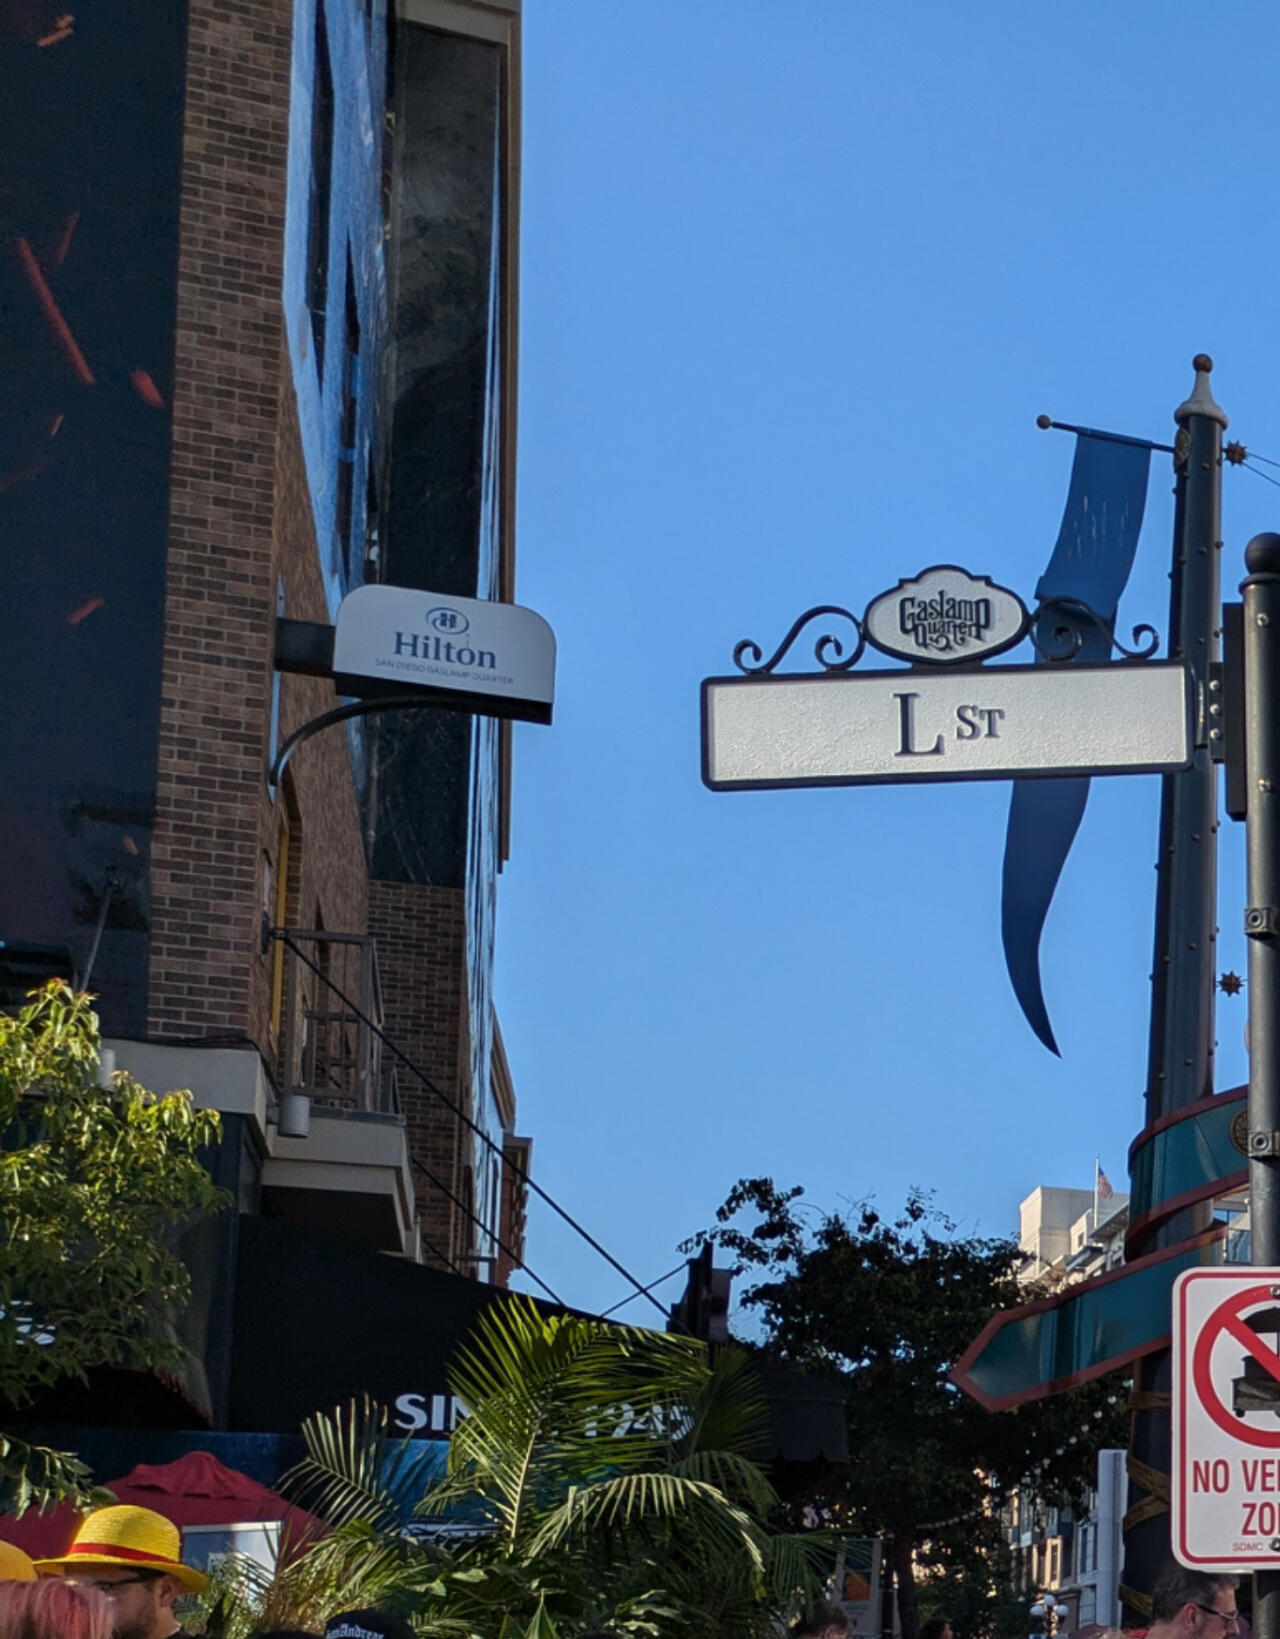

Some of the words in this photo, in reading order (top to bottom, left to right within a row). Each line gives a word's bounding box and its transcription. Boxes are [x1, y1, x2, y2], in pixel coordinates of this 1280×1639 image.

[900, 589, 991, 635] Gaslamp
[394, 631, 497, 669] Hilton
[914, 619, 984, 652] Quarter
[375, 657, 395, 668] SAN
[396, 660, 424, 673] DIEGO
[426, 665, 470, 679] GASLAMP
[471, 671, 514, 685] QUARTER
[892, 691, 945, 758] L
[955, 703, 1006, 741] ST
[1192, 1458, 1230, 1494] NO
[1232, 1542, 1264, 1552] SDMC
